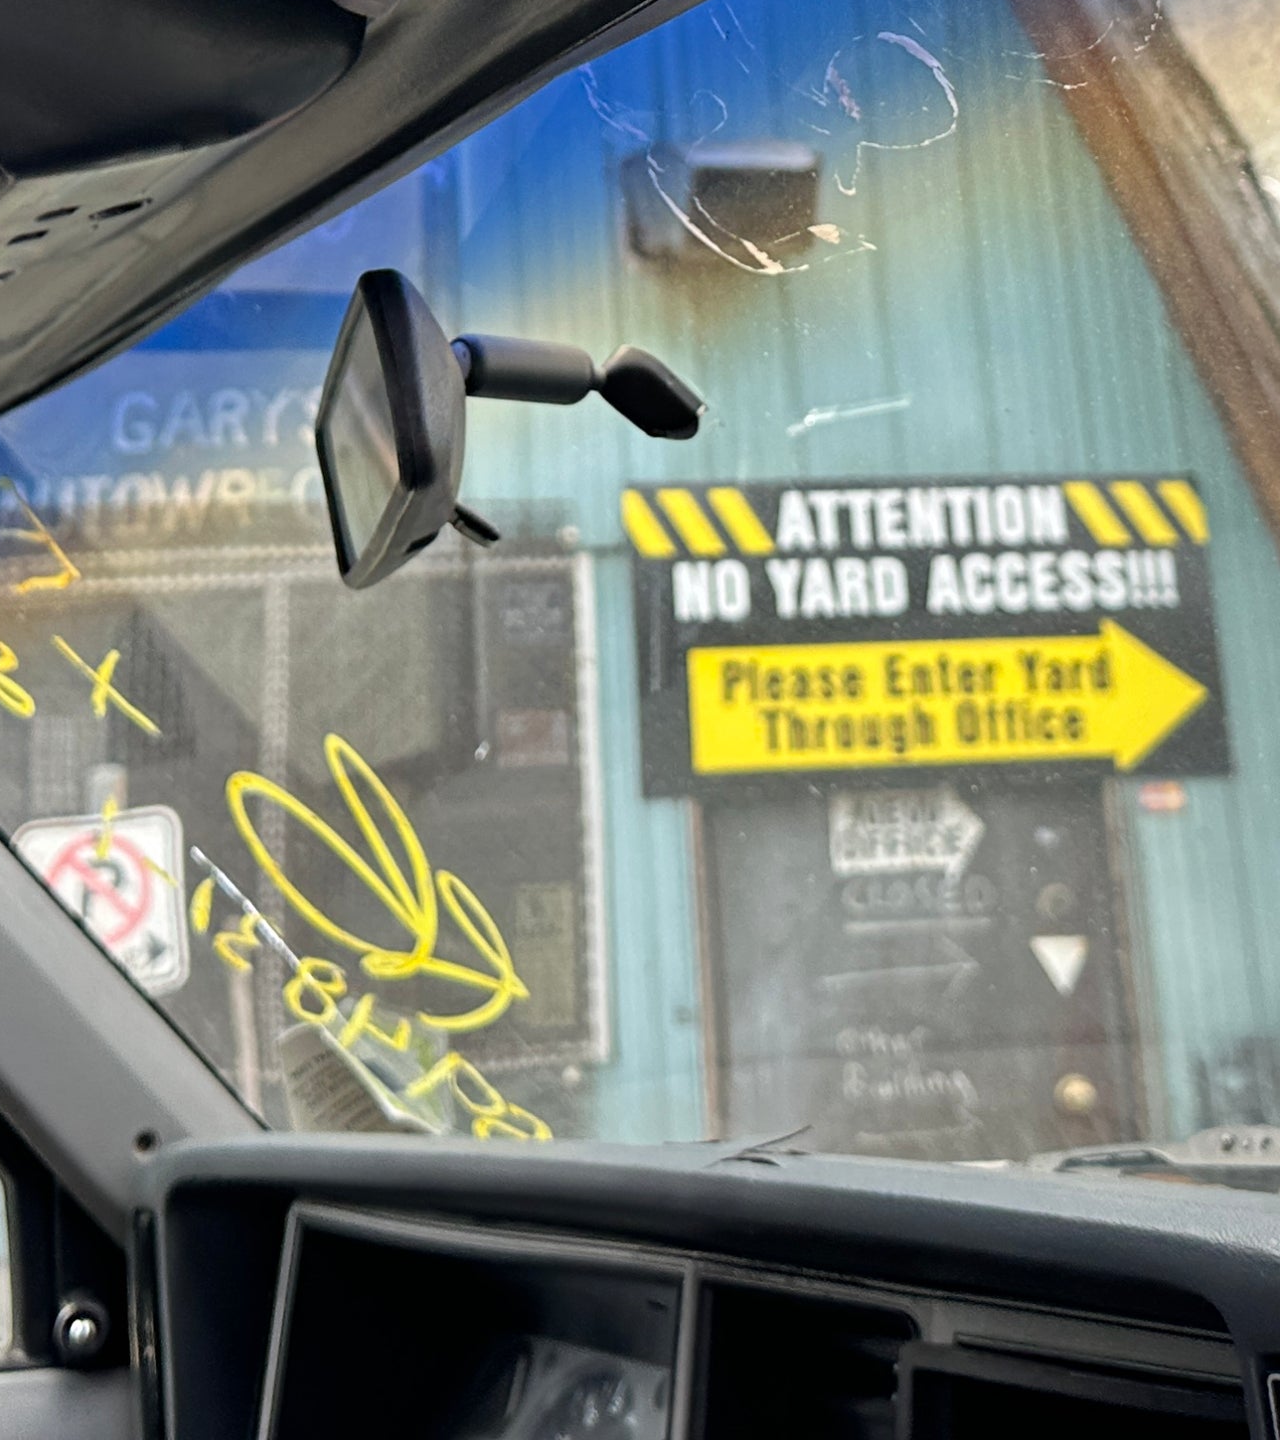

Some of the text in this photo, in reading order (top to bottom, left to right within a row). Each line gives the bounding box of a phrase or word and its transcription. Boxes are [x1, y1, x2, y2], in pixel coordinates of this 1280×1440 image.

[775, 484, 1069, 551] ATTENTION
[672, 548, 1180, 623] NO YARD ACCESS!!!
[720, 647, 1115, 702] Please Enter Yard
[761, 697, 1087, 754] Through Office
